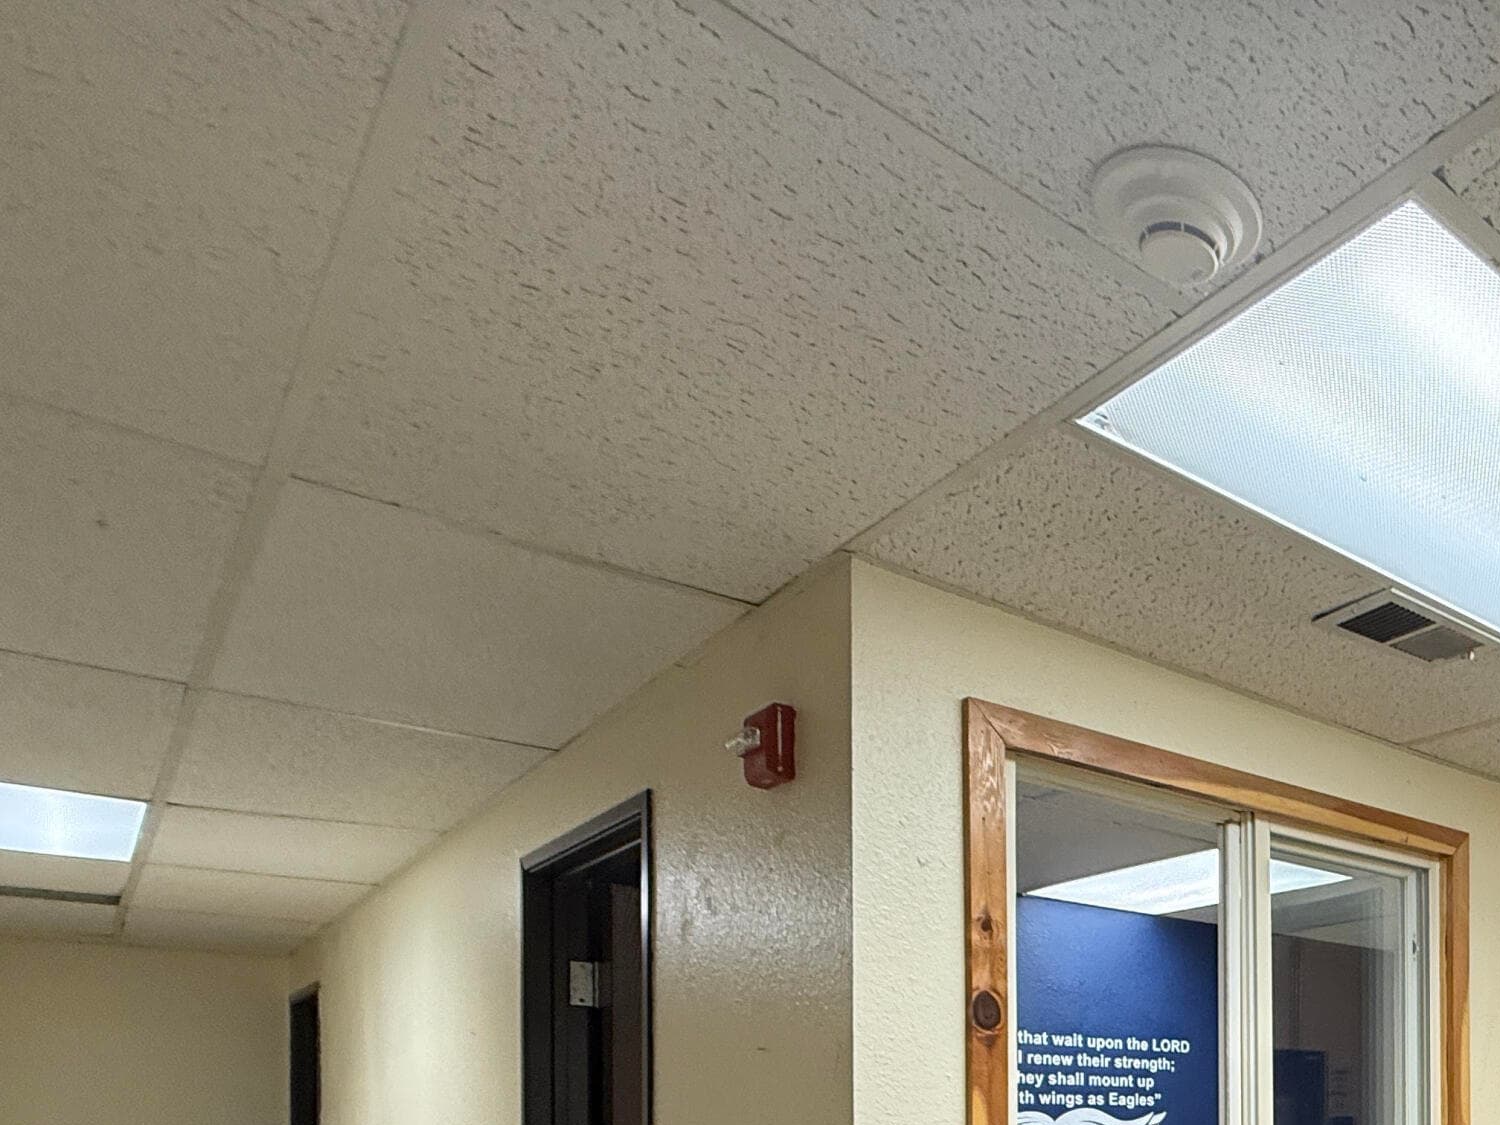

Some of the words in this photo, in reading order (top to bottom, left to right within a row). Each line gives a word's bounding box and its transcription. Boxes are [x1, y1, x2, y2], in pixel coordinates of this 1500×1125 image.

[1018, 1029, 1049, 1046] that
[1051, 1032, 1083, 1048] wait
[1087, 1036, 1123, 1051] upon
[1126, 1036, 1149, 1051] the
[1152, 1038, 1190, 1054] LORD
[1027, 1053, 1073, 1066] renew
[1077, 1052, 1111, 1068] their
[1114, 1055, 1175, 1073] strength;
[1017, 1070, 1044, 1088] hey
[1048, 1071, 1085, 1086] shall
[1088, 1074, 1134, 1088] mount
[1136, 1077, 1155, 1091] up
[1018, 1090, 1035, 1105] th
[1038, 1090, 1084, 1109] wings
[1087, 1094, 1105, 1106] as
